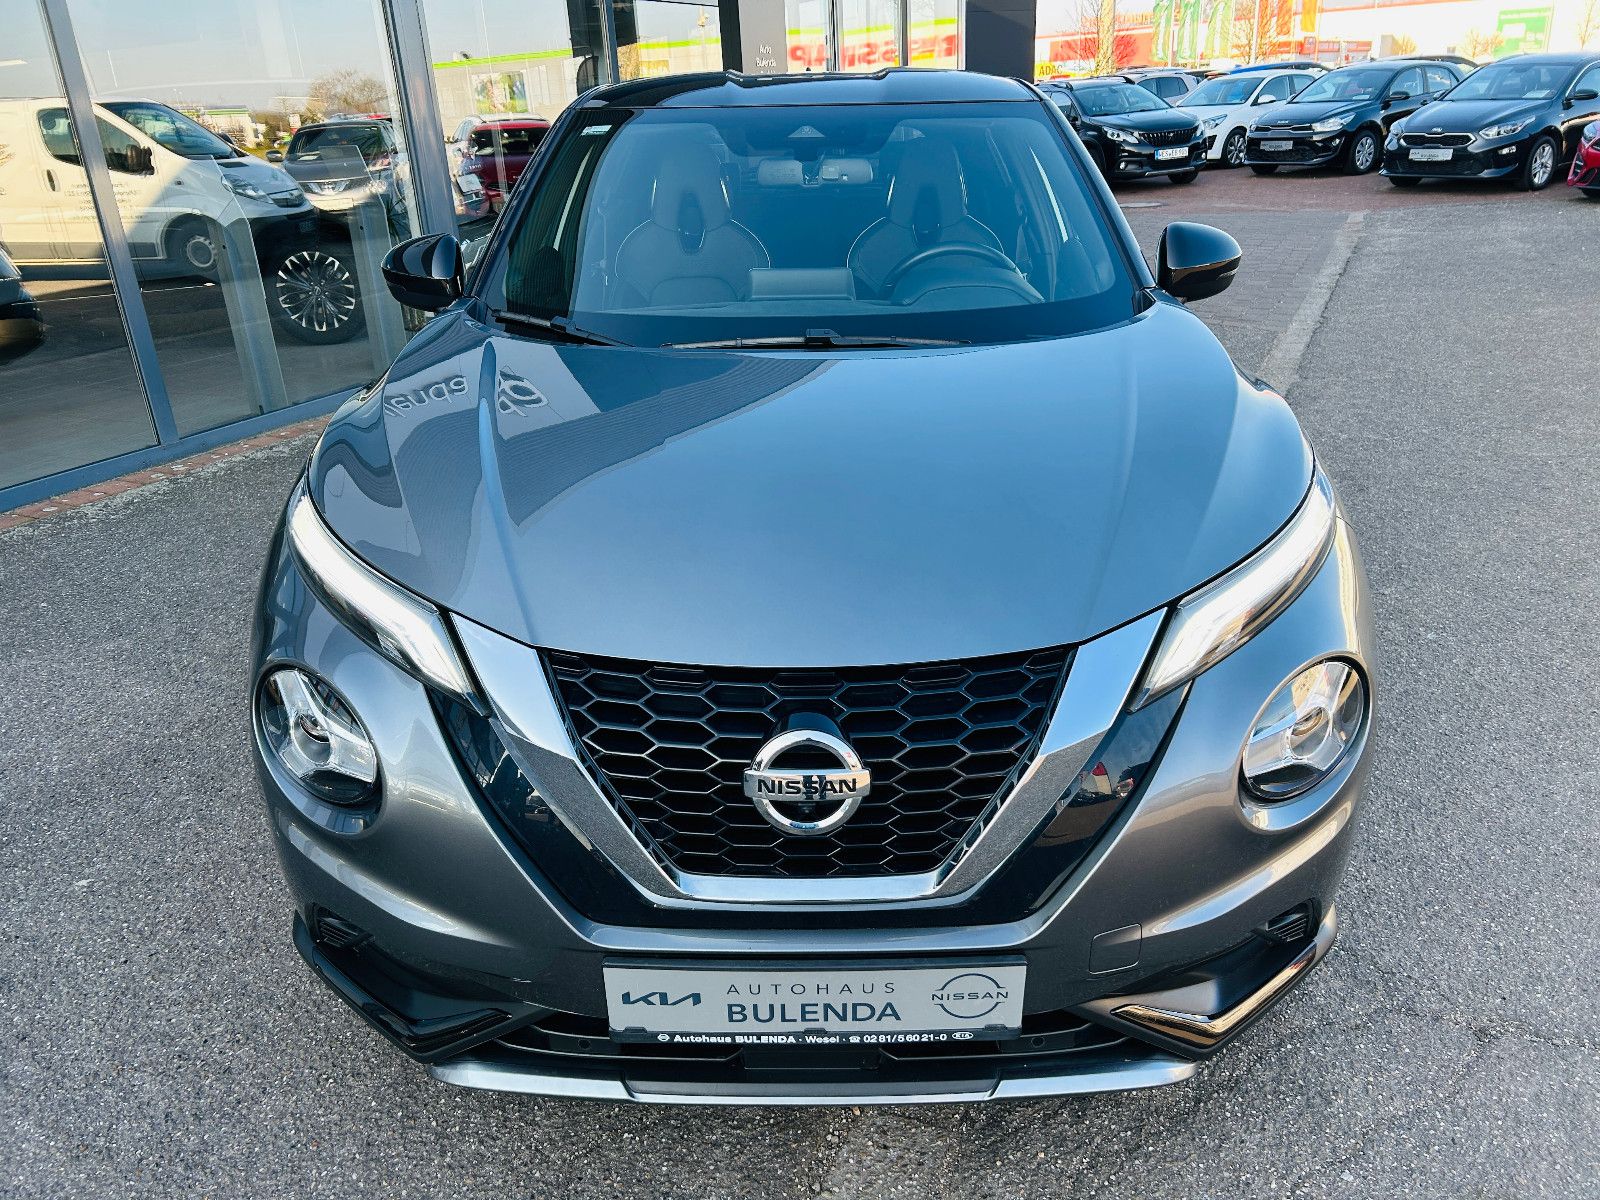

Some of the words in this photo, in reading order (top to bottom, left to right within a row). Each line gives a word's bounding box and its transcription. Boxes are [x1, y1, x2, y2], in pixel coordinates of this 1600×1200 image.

[757, 778, 858, 796] NISSAN
[726, 982, 895, 996] AUTOHAUS
[931, 991, 1009, 1001] NISSAN
[621, 991, 702, 1007] KIA
[727, 1002, 902, 1024] BULENDA
[673, 1034, 732, 1043] Autohaus
[735, 1035, 796, 1044] BULENDA
[804, 1034, 840, 1043] Wesel
